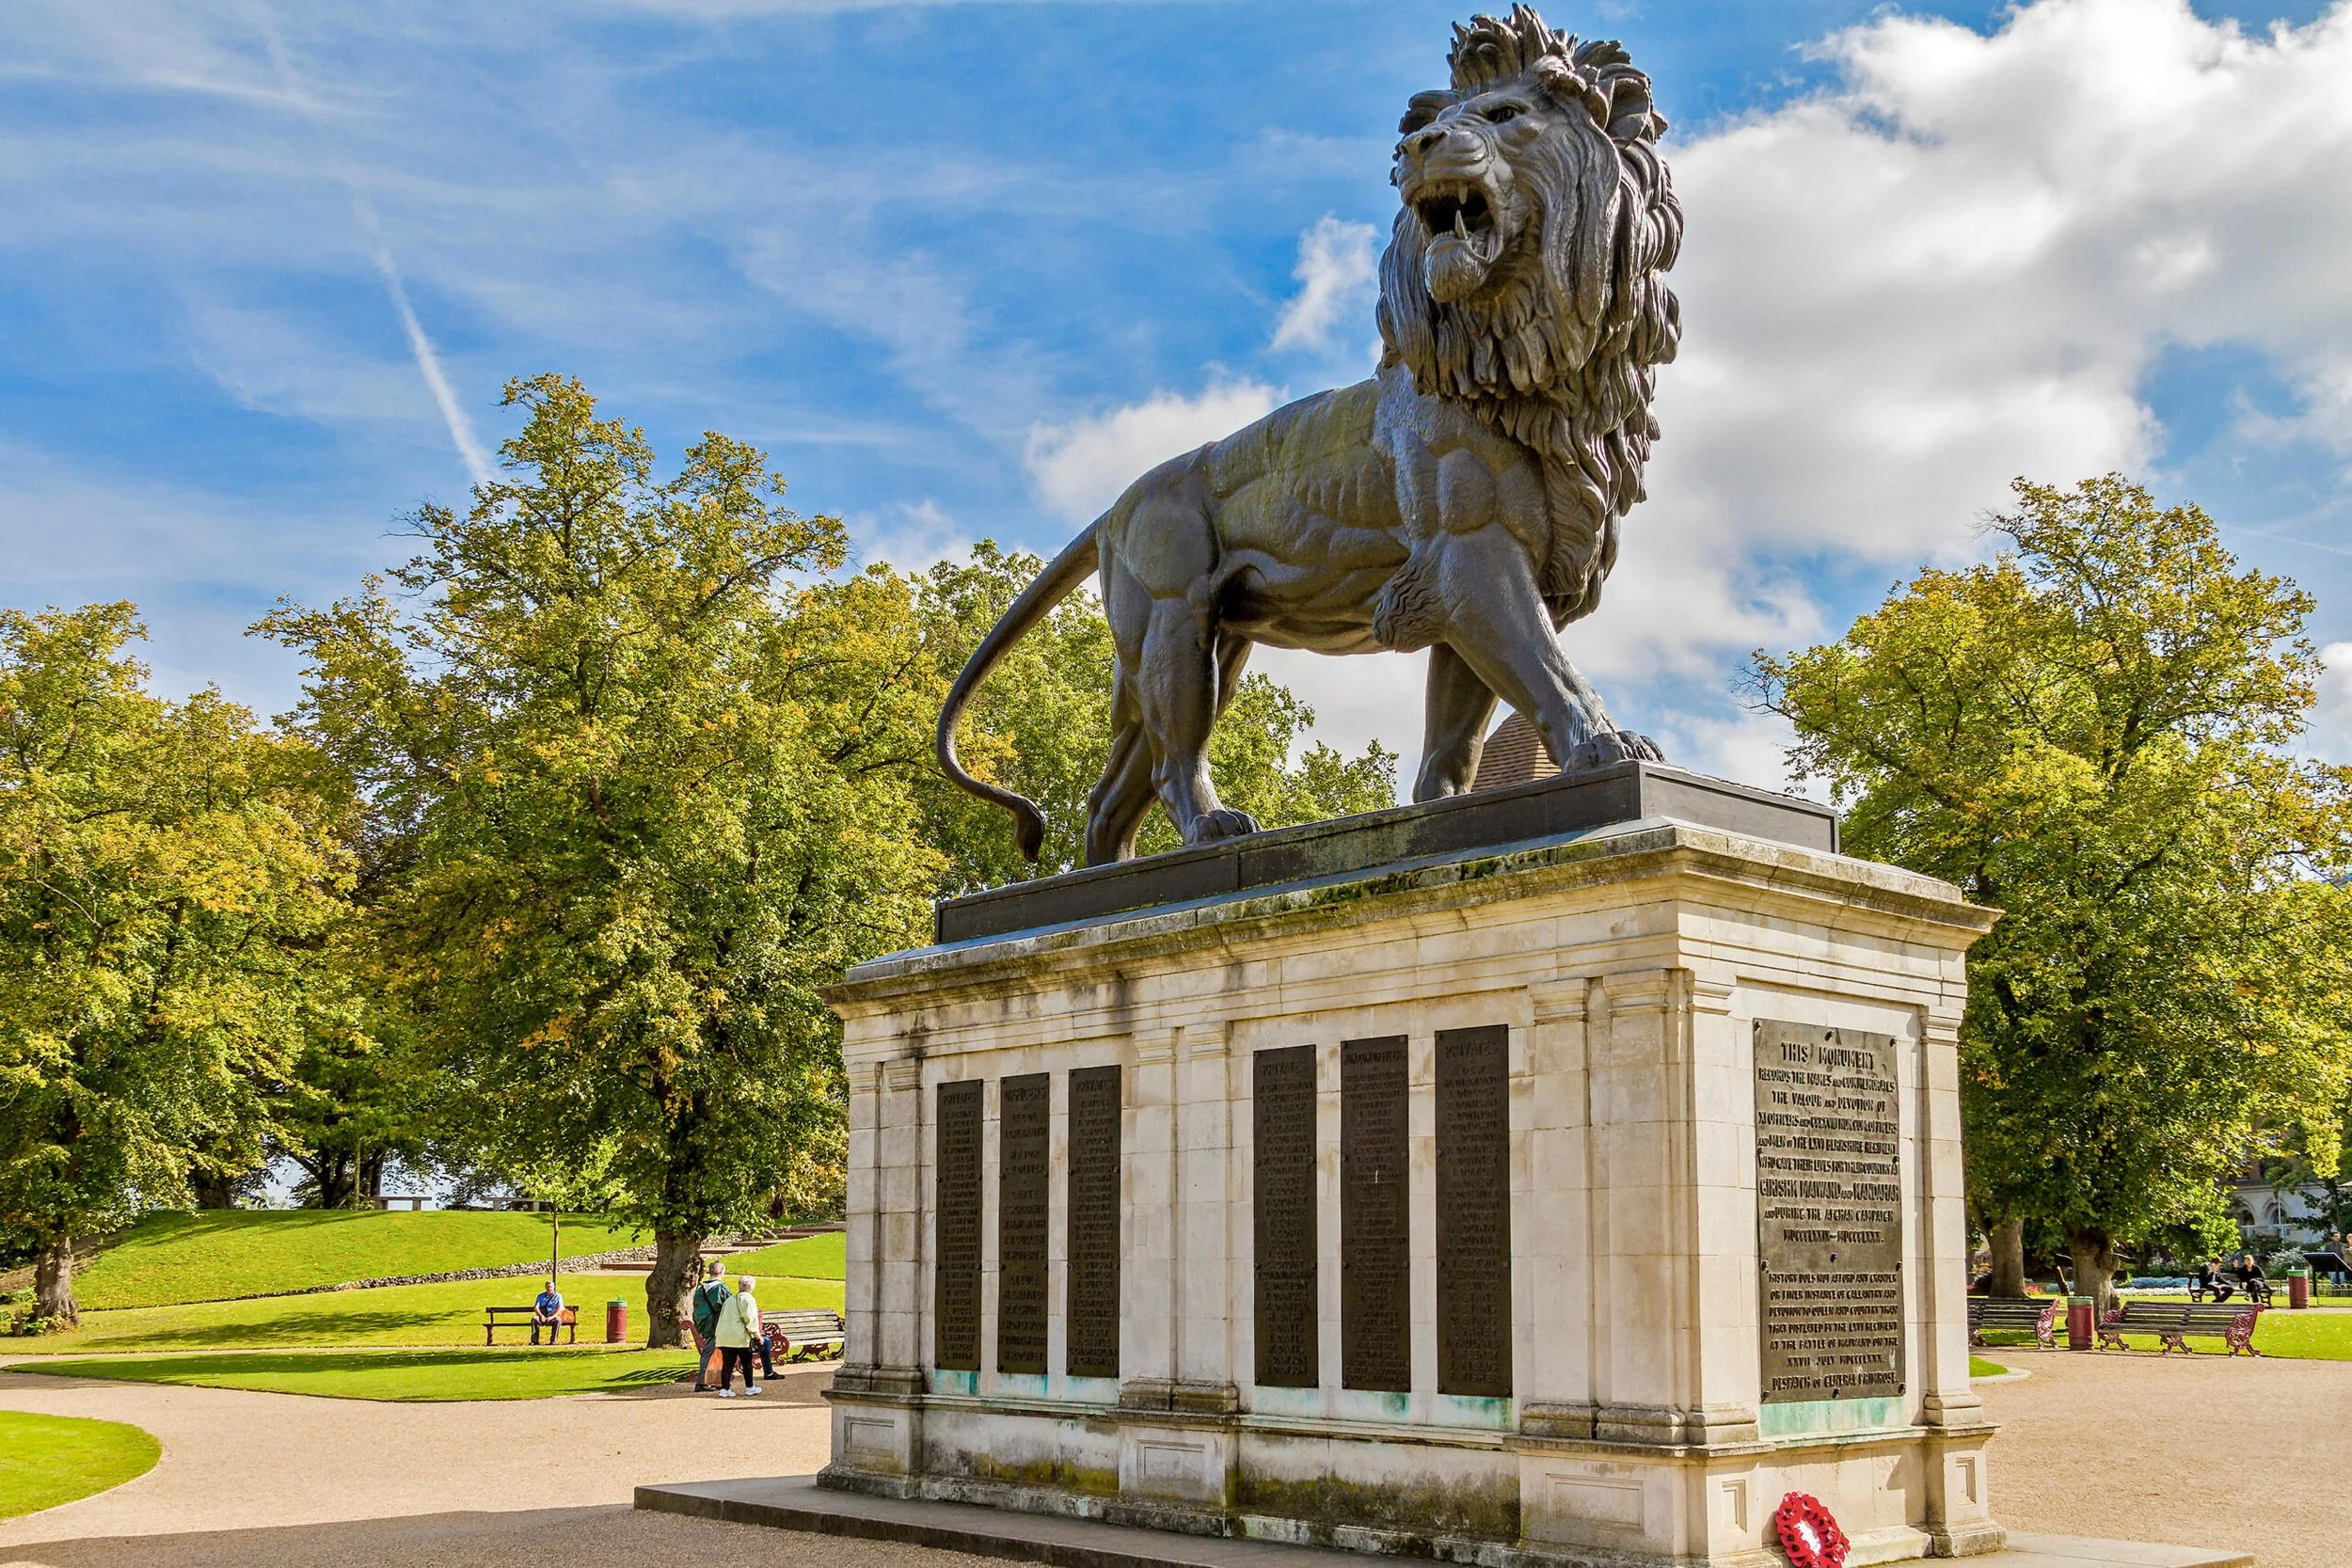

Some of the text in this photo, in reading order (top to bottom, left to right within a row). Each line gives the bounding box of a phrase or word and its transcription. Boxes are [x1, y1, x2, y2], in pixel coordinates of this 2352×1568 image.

[1445, 1039, 1498, 1060] PRIVATES
[1781, 1042, 1874, 1069] THIS MONUMENT
[1758, 1068, 1790, 1083] RECORDS
[1791, 1070, 1805, 1085] THE
[1807, 1072, 1832, 1086] NAMES
[1772, 1090, 1886, 1113] THE VALOUR AND DEVOTION OF
[1768, 1112, 1800, 1127] OFFICERS
[1769, 1134, 1786, 1148] MEN
[1792, 1136, 1807, 1149] THE
[1826, 1138, 1864, 1153] BERKSHIRE
[1864, 1141, 1896, 1155] REGIMENT
[1758, 1155, 1775, 1169] WHO
[1776, 1157, 1792, 1171] GAVE
[1792, 1158, 1813, 1172] THEIR
[1813, 1159, 1832, 1173] LIVES
[1799, 1180, 1841, 1199] MAIWAND
[1841, 1189, 1853, 1200] AND
[1853, 1181, 1899, 1202] KANDAHAR
[1774, 1206, 1805, 1221] DURING
[1806, 1207, 1822, 1221] THE
[1825, 1208, 1853, 1222] AFGHAN
[1855, 1210, 1894, 1223] CAMPAIGN
[1769, 1273, 1798, 1284] HISTORY
[1799, 1273, 1816, 1284] DOES
[1782, 1290, 1804, 1300] FINER
[1836, 1290, 1845, 1300] OF
[1834, 1322, 1848, 1333] THE
[1770, 1339, 1780, 1351] AT
[1781, 1339, 1797, 1351] THE
[1799, 1338, 1826, 1350] BATTLE
[1827, 1338, 1837, 1349] OF
[1883, 1337, 1899, 1347] THE
[1816, 1355, 1836, 1367] JULY
[1772, 1376, 1811, 1391] DESPATCH
[1824, 1373, 1857, 1387] GENERAL
